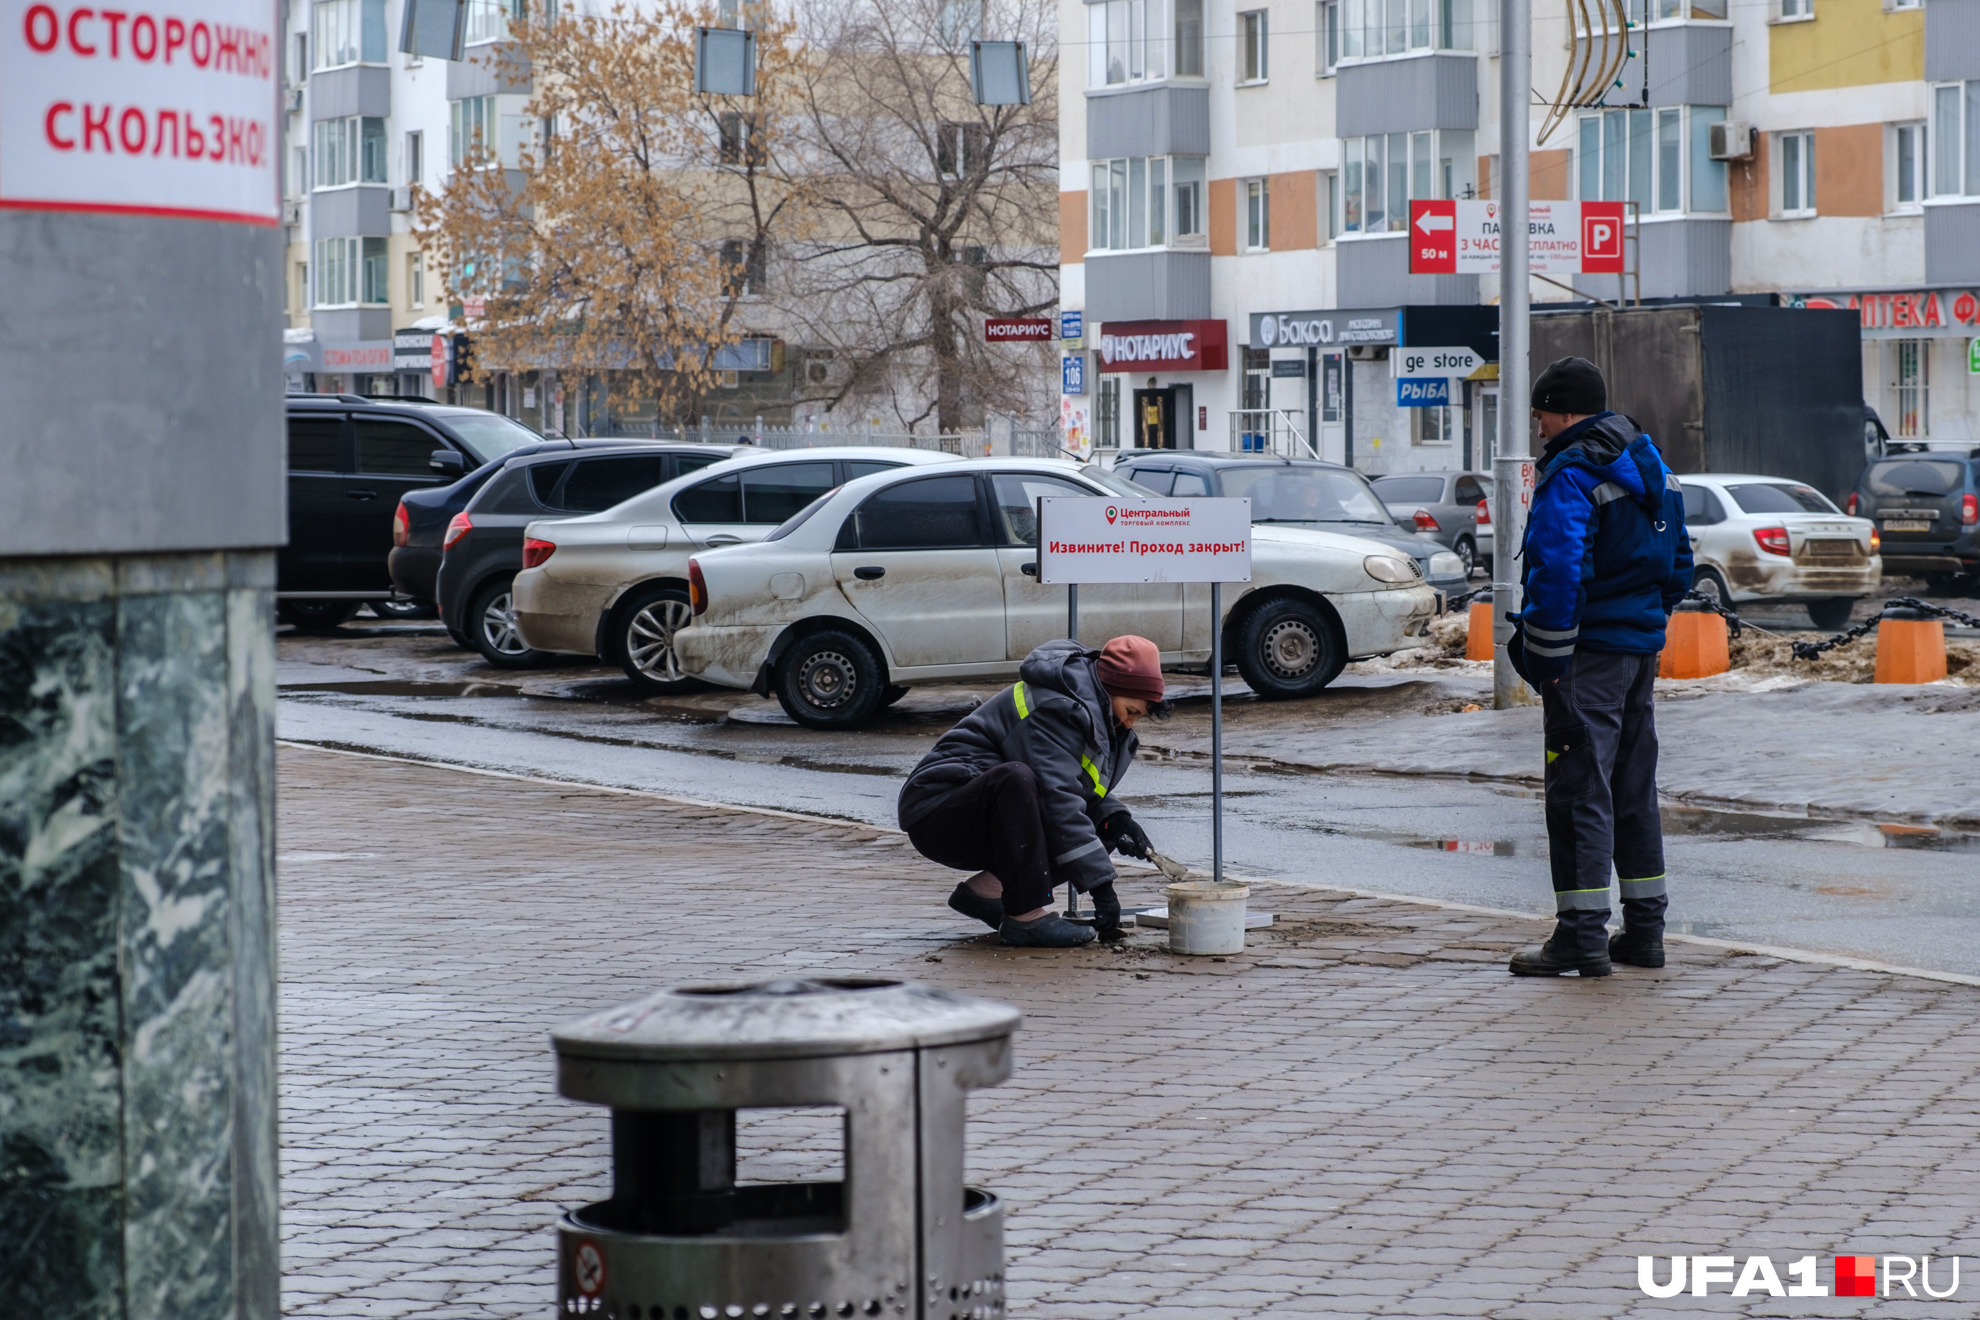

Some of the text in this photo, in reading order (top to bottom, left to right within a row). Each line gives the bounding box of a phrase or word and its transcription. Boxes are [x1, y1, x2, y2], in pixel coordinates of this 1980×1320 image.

[1482, 222, 1555, 234] ПАВКА
[1421, 248, 1436, 259] 50
[988, 324, 1049, 336] НОТАРИУС
[1115, 332, 1195, 361] НОТАРИУС
[1406, 352, 1474, 373] ge store
[1065, 367, 1081, 385] 106
[1400, 383, 1448, 399] РЫБА
[1120, 508, 1190, 519] Центральный
[1050, 540, 1245, 556] Извините! Проход закрыт!
